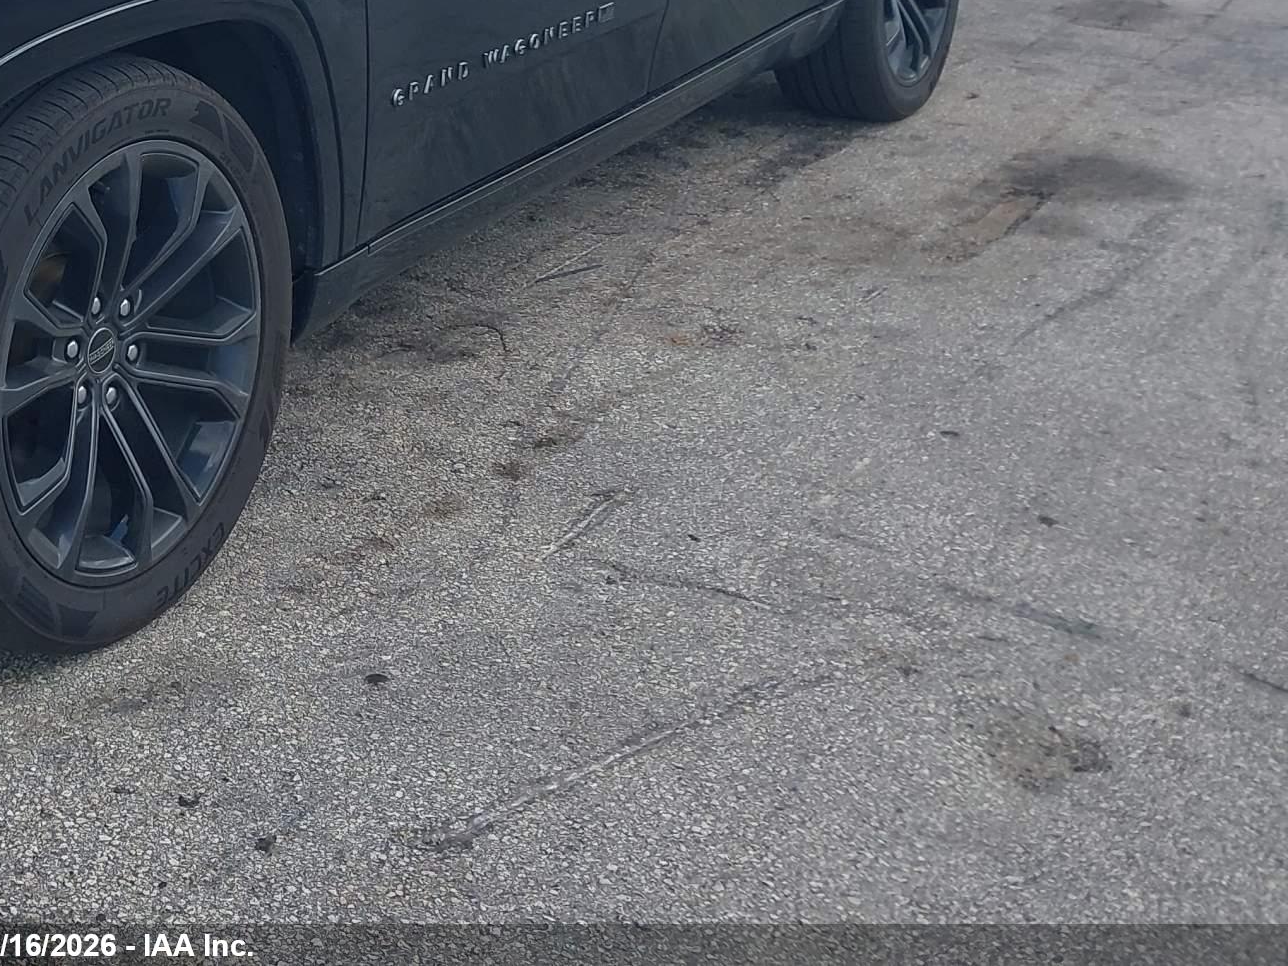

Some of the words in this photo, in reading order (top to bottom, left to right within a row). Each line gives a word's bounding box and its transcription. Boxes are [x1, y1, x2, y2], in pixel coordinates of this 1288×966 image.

[391, 61, 469, 107] GRAND
[482, 10, 596, 69] WAGONEER
[24, 97, 172, 227] LANVIGATOR
